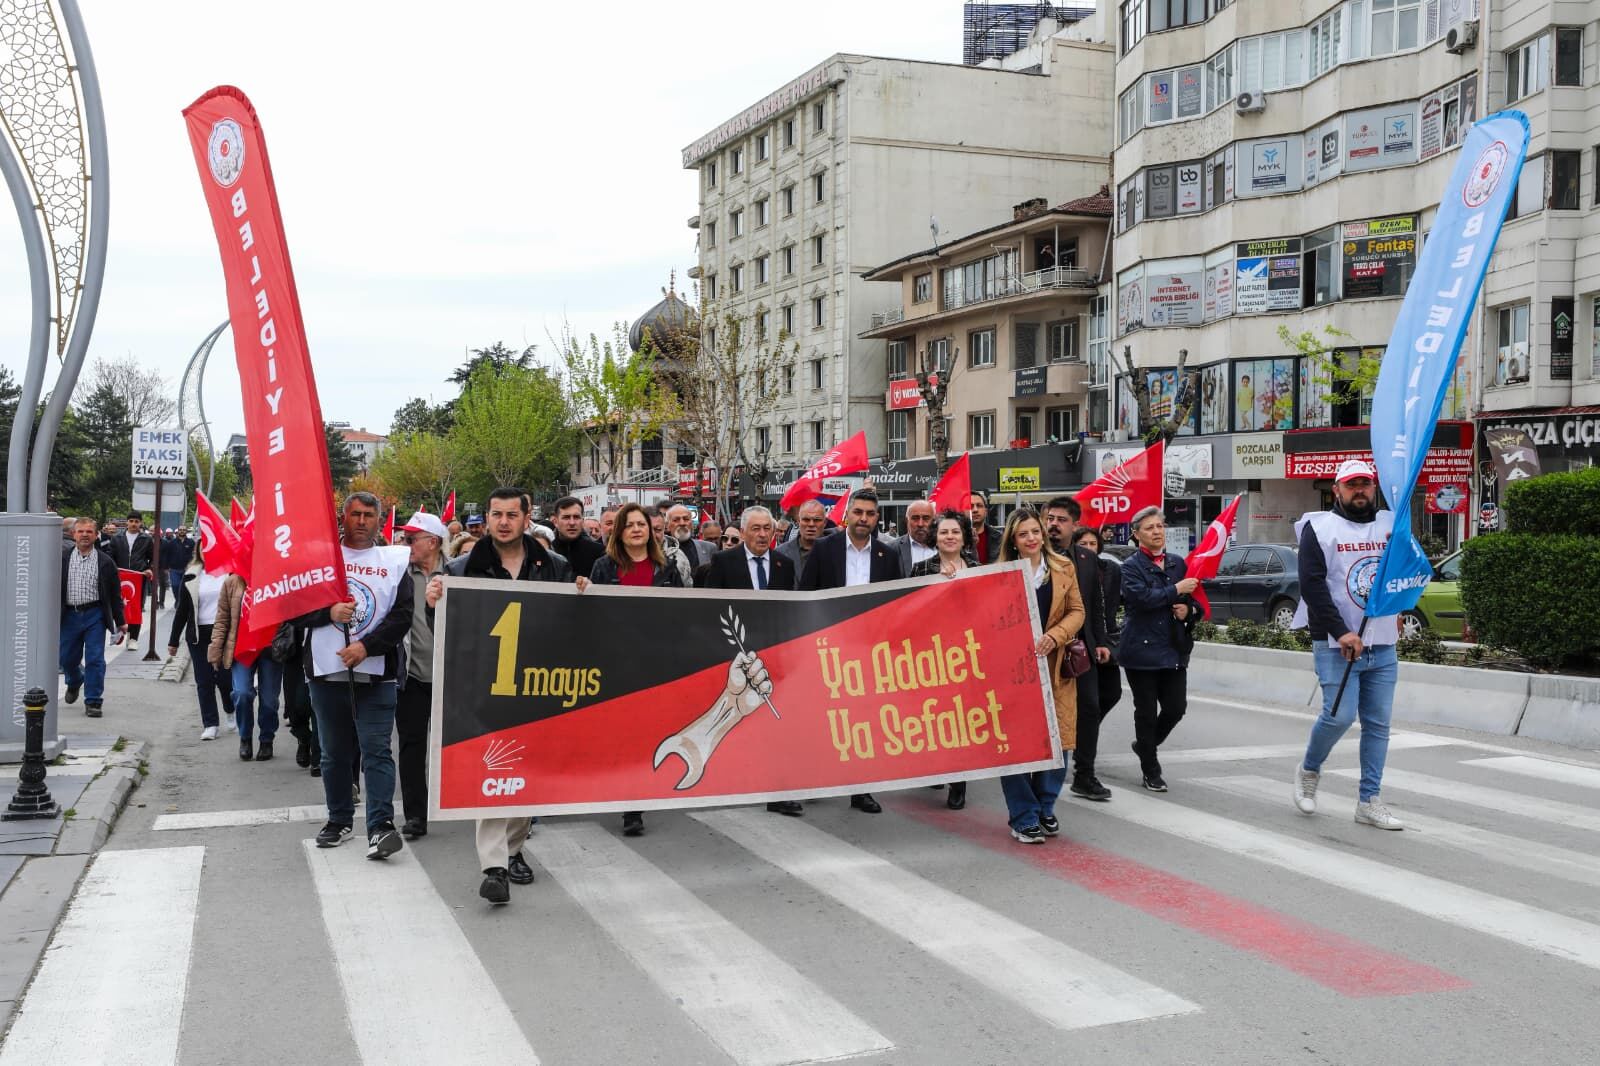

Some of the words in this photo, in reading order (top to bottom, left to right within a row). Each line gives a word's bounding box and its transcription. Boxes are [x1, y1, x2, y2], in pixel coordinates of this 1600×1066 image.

[1258, 163, 1281, 172] MYK
[1367, 239, 1415, 253] Fentaş
[1174, 291, 1199, 301] BİRLİĞİ
[140, 432, 182, 444] EMEK
[1236, 443, 1281, 455] BOZCALAR
[1242, 456, 1274, 467] ÇARŞISI
[135, 465, 154, 475] 214
[156, 466, 169, 475] 44
[172, 467, 184, 476] 74
[14, 535, 31, 607] BELEDİYESİ
[489, 602, 522, 696] 1
[522, 667, 602, 707] mayıs
[871, 629, 986, 695] Adalet
[826, 708, 875, 762] Ya
[481, 776, 526, 797] CHP
